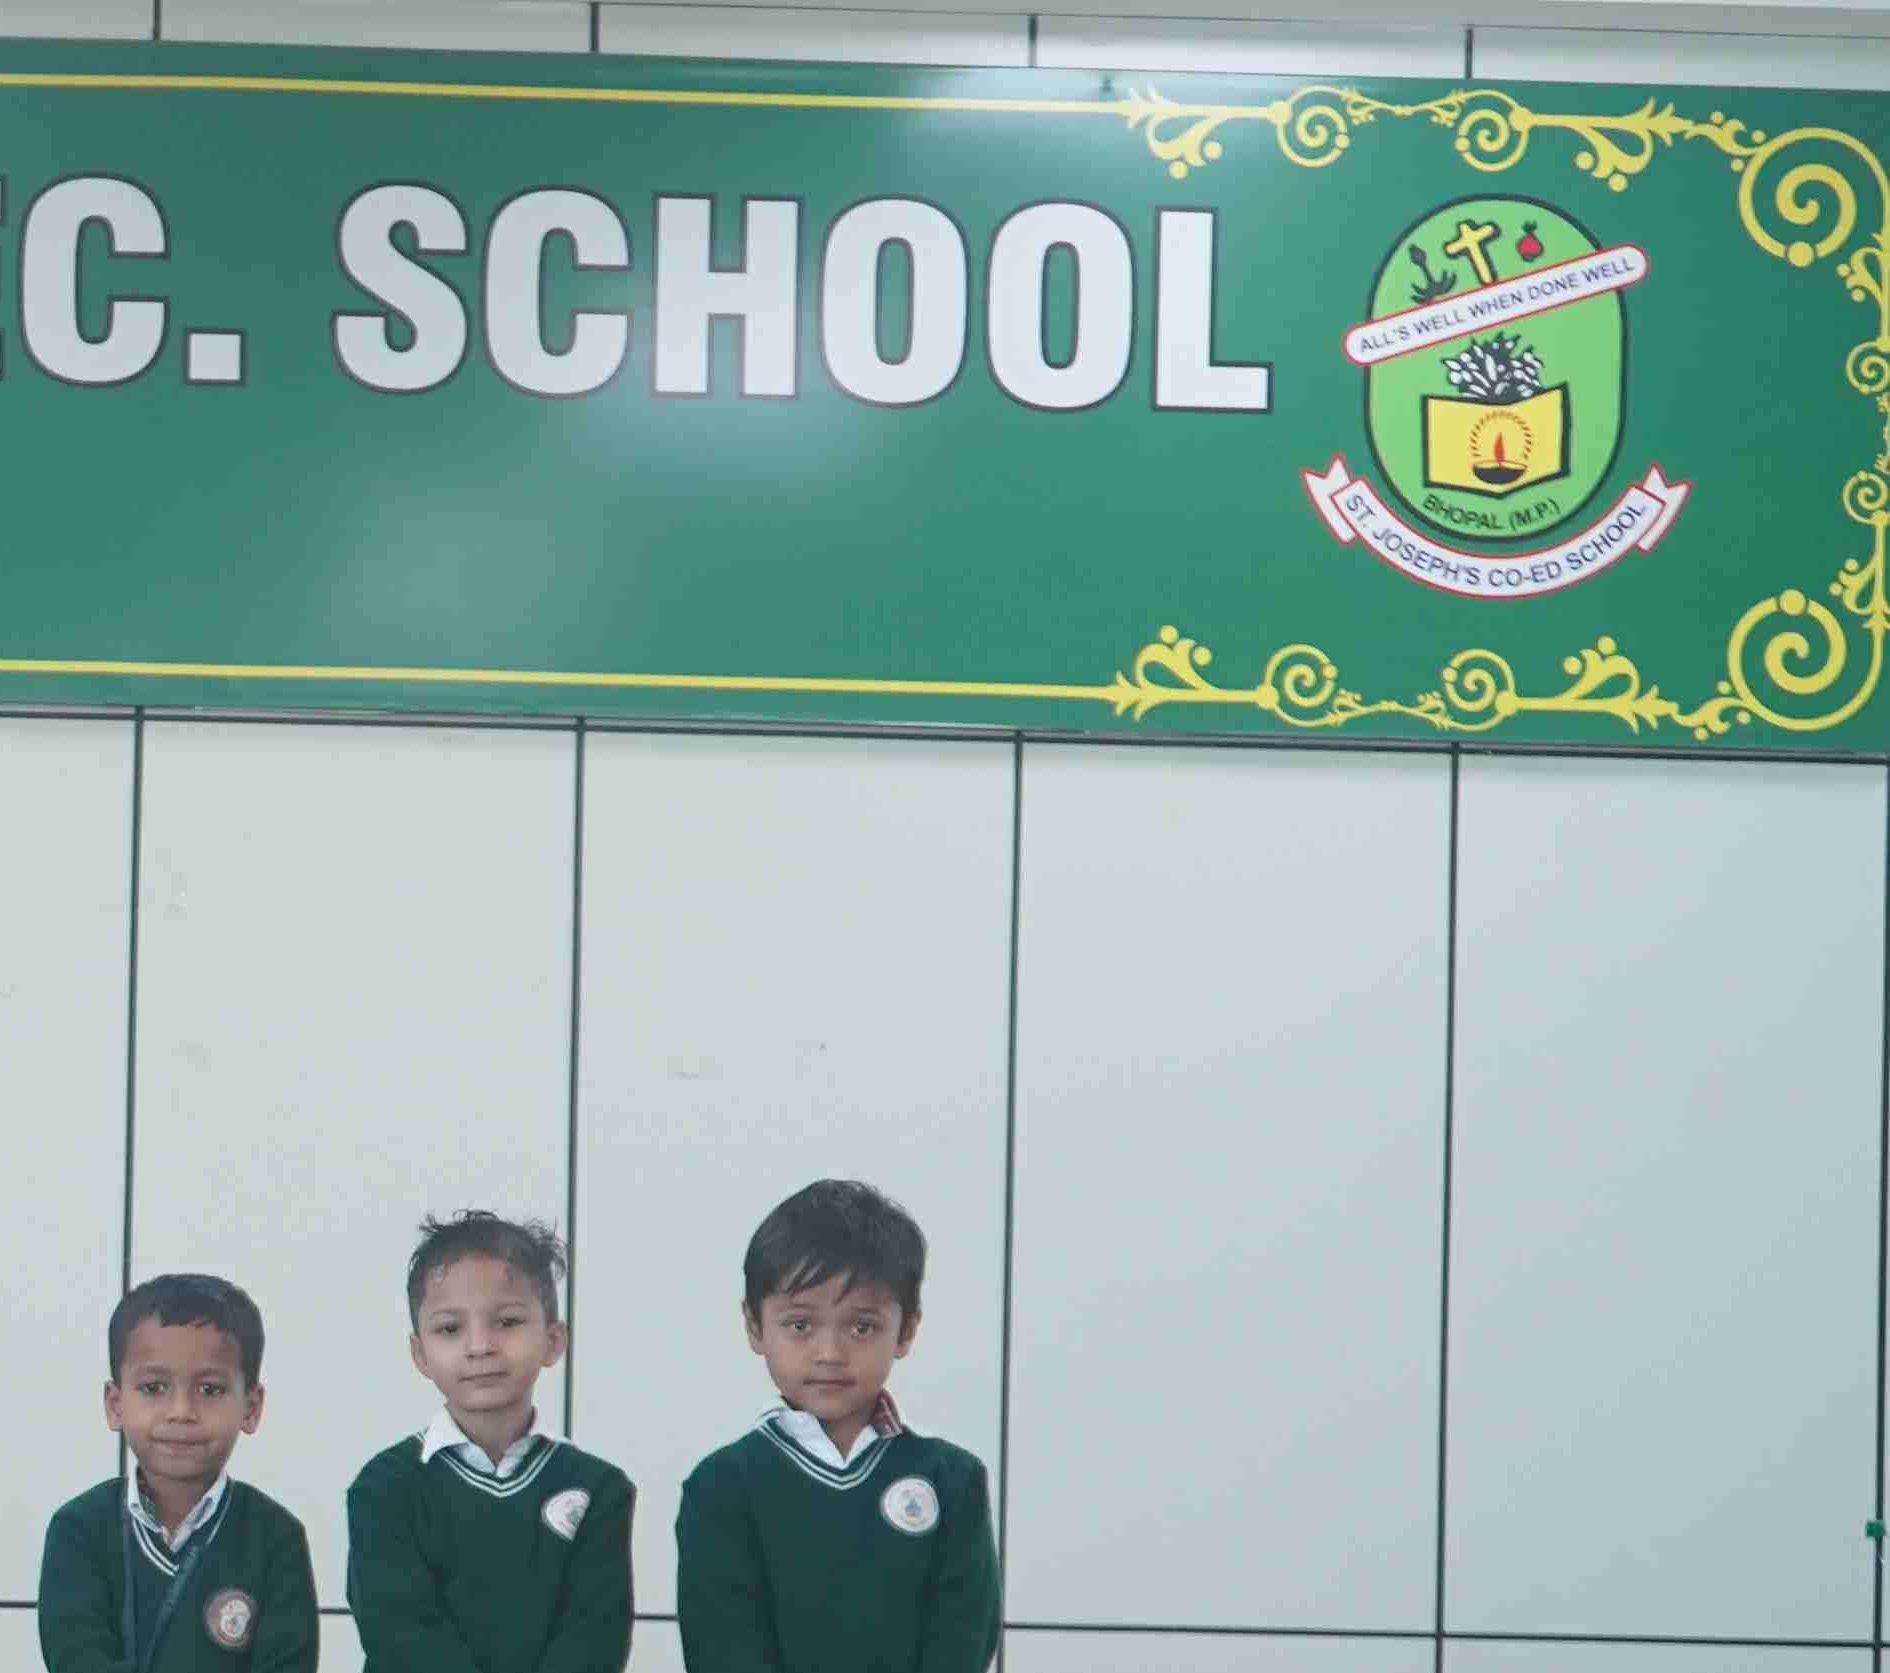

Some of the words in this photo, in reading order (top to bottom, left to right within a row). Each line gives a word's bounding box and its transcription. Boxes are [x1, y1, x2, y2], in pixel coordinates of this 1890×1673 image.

[335, 185, 1271, 414] SCHOOL
[1359, 327, 1411, 353] ALL'S
[1413, 307, 1466, 336] WELL
[1467, 290, 1525, 322] WHEN
[1528, 274, 1580, 302] DONE
[1583, 257, 1637, 284] WELL
[1345, 494, 1377, 528] ST.
[1371, 527, 1481, 586] JOSEPH'S
[1488, 560, 1562, 588] CO-ED
[1565, 503, 1648, 572] SCHOOL
[1421, 493, 1504, 530] BHOPAL
